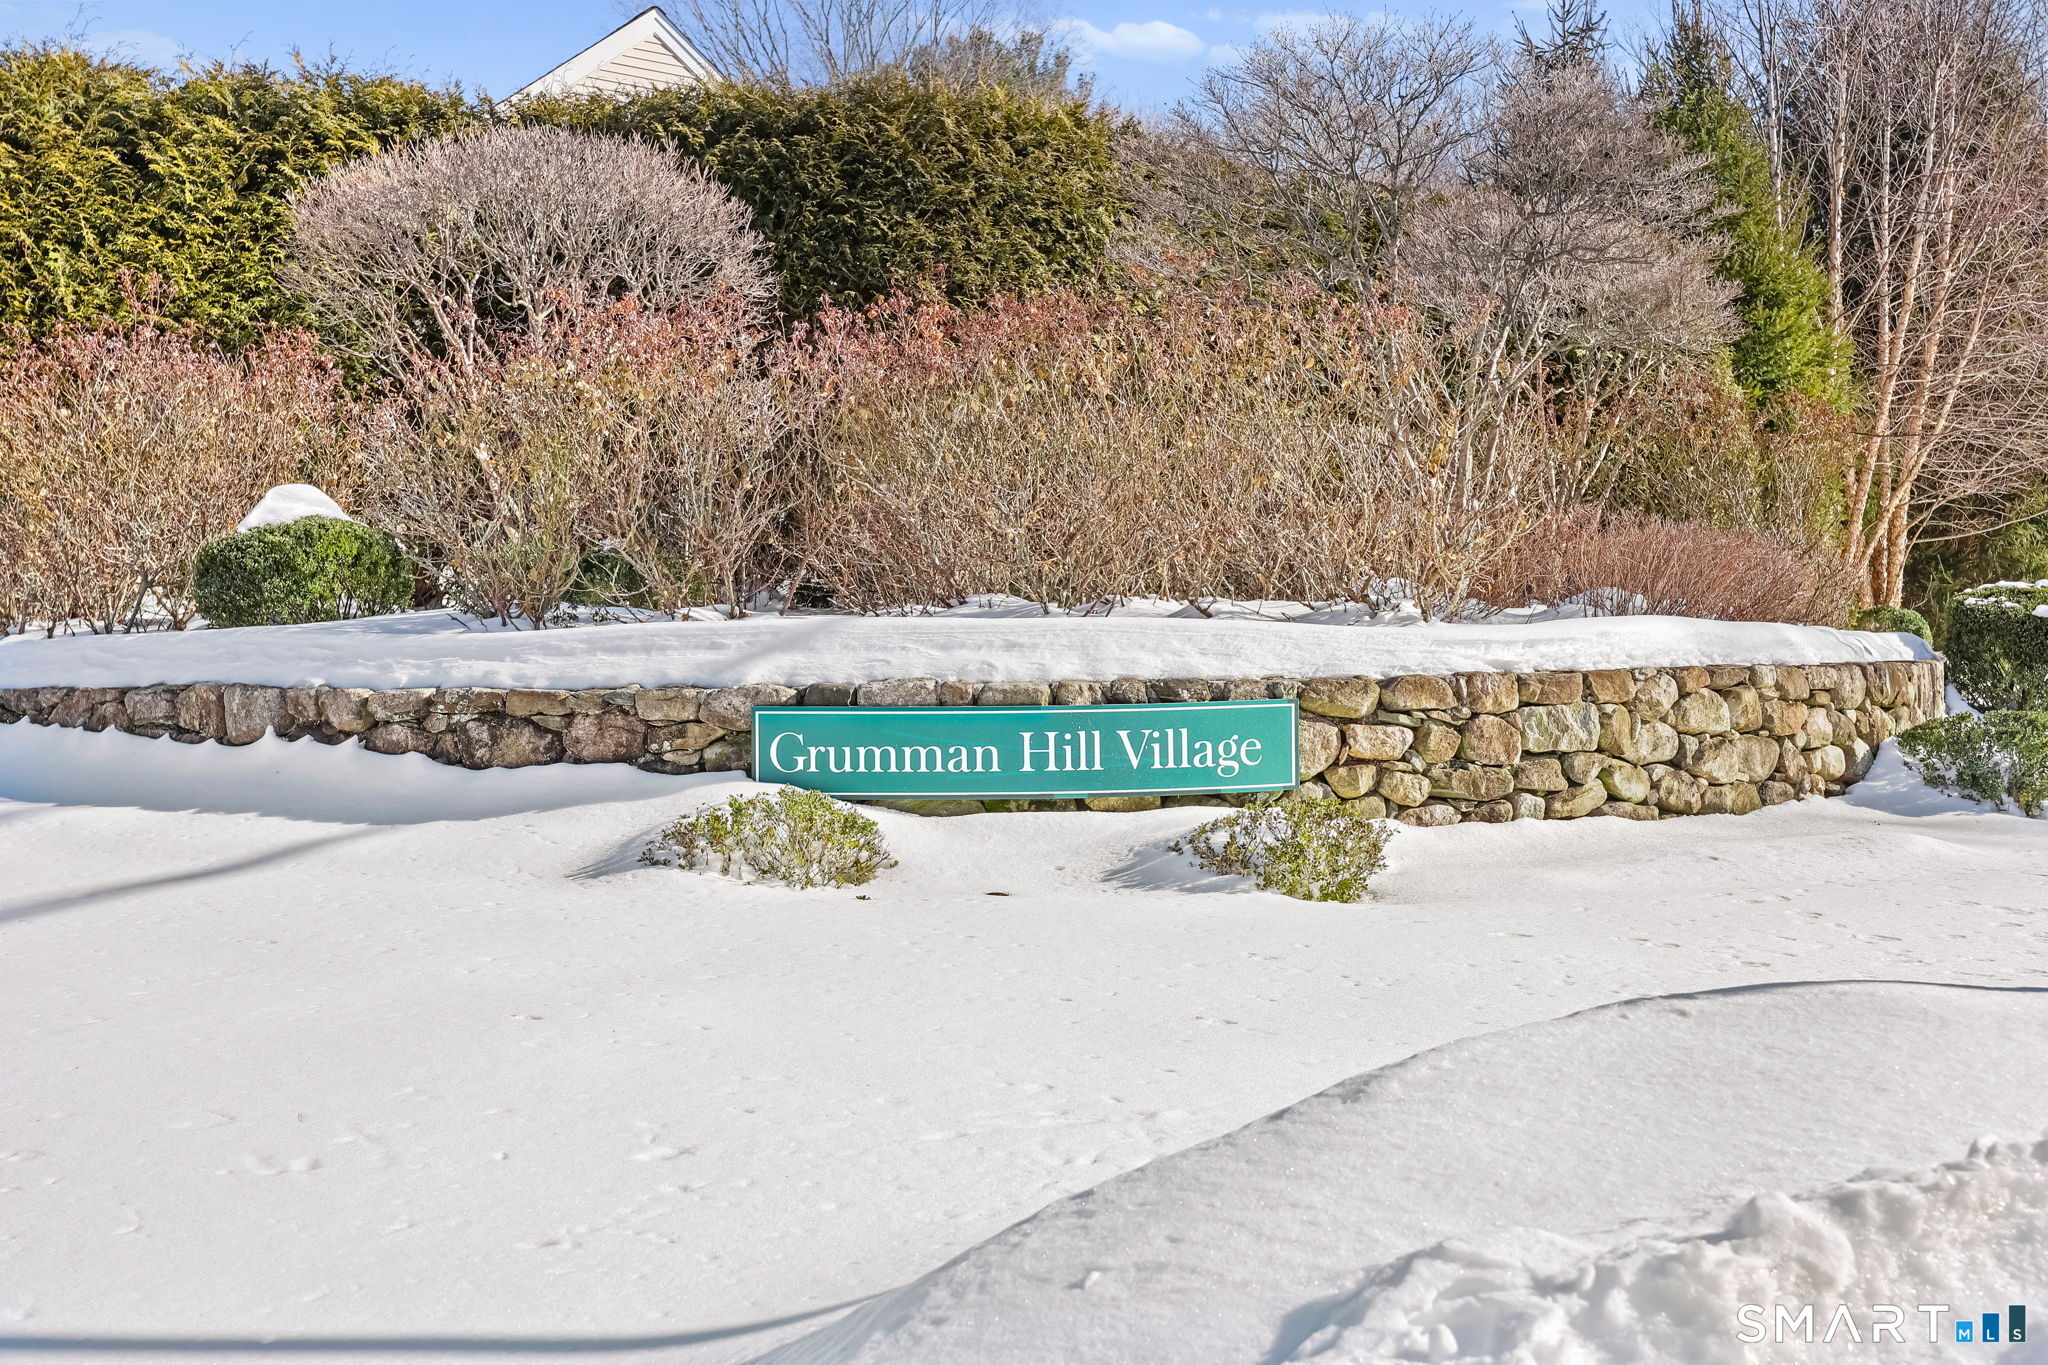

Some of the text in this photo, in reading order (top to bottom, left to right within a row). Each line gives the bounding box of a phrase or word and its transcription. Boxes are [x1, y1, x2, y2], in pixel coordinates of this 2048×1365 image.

[768, 727, 1263, 778] Grumman Hill Village
